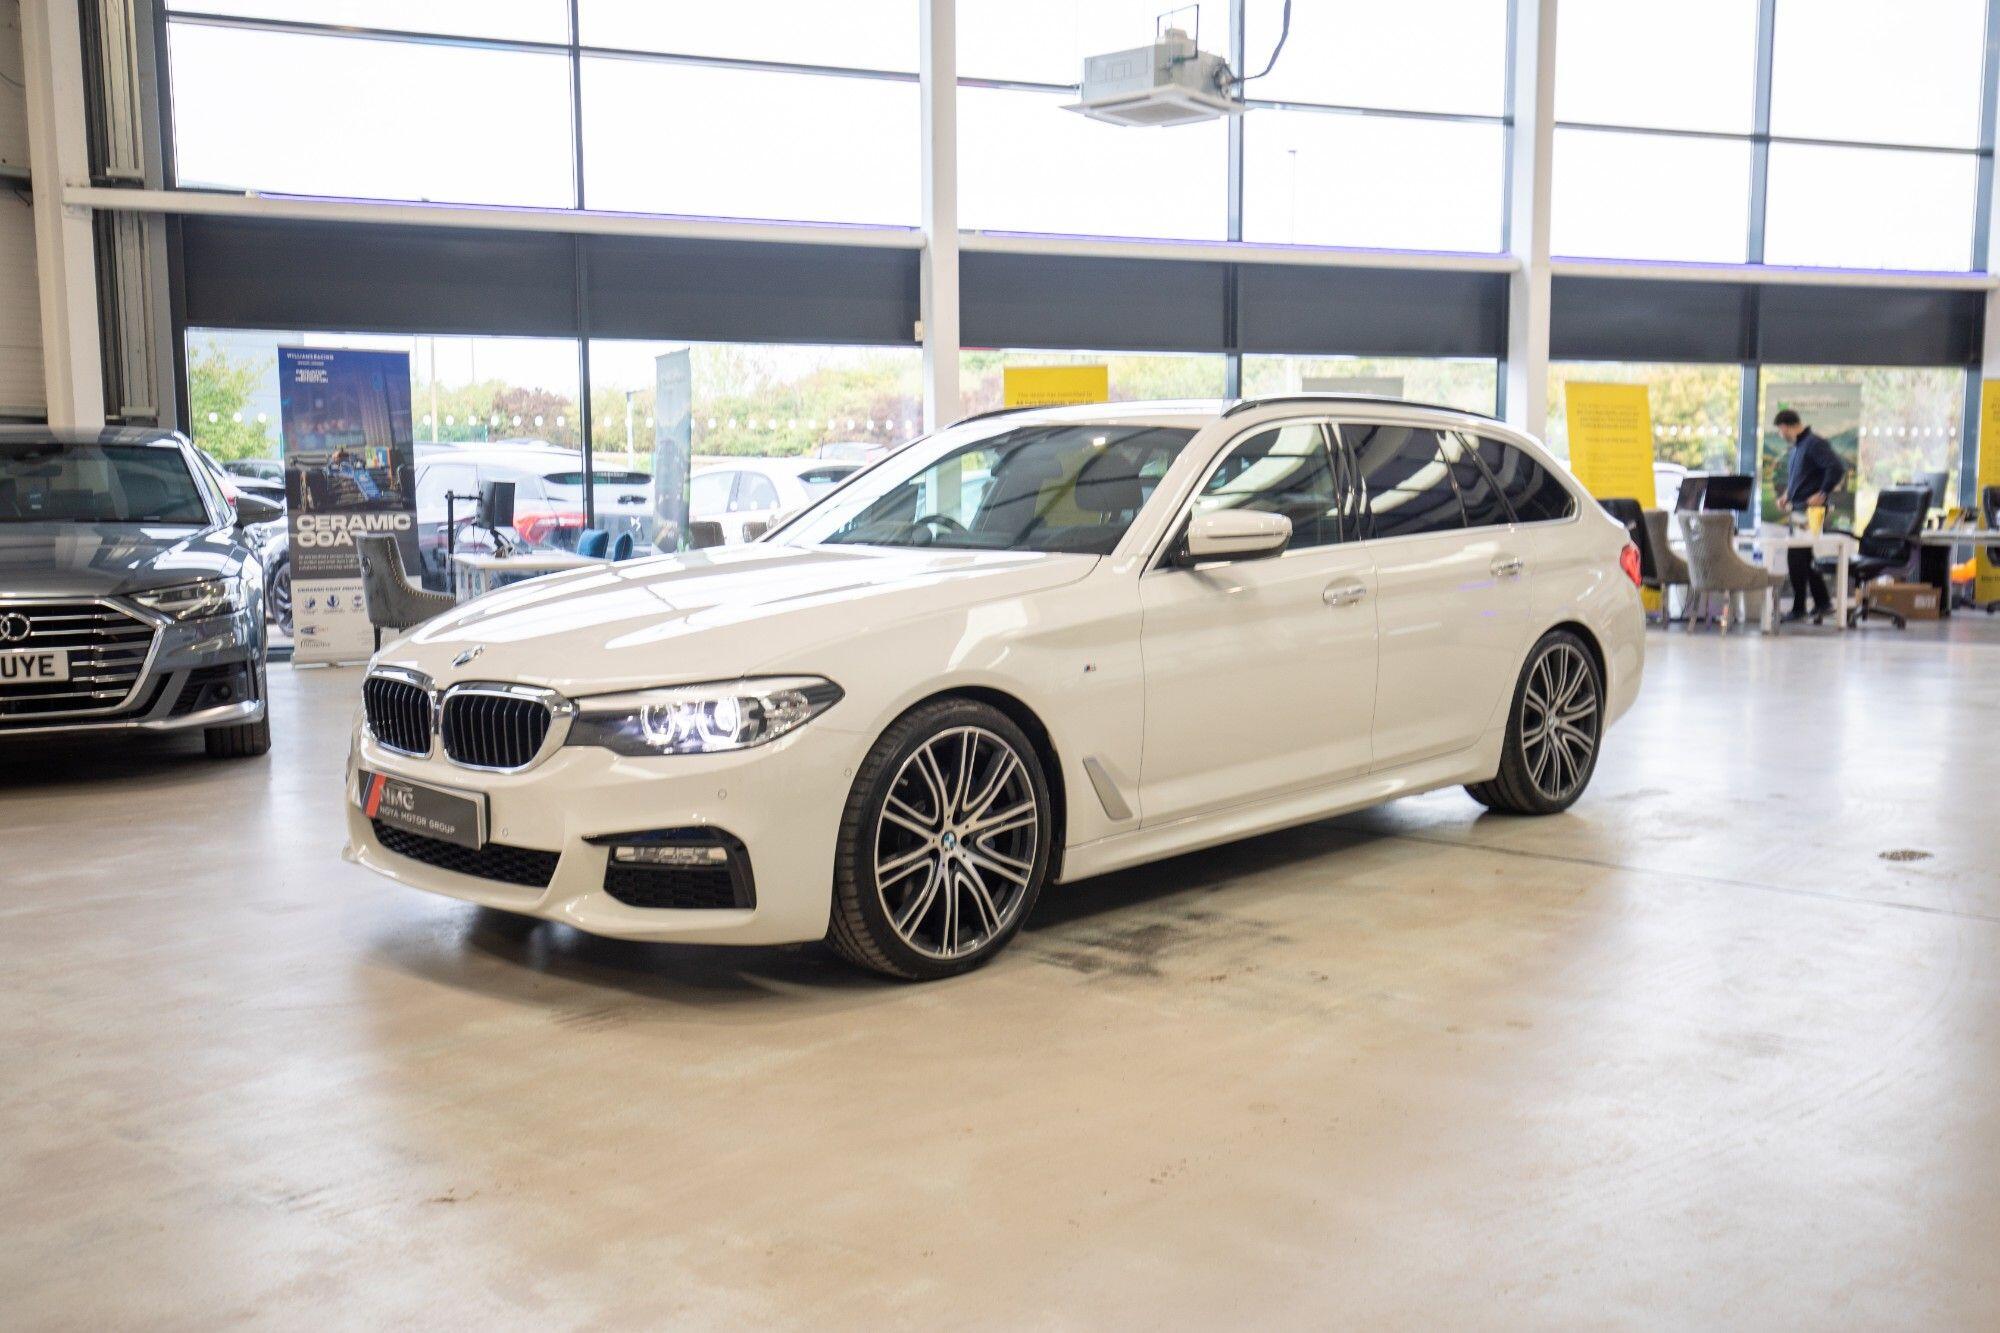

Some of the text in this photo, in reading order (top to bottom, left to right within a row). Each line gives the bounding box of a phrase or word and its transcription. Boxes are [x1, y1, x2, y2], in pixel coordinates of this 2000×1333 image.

[296, 513, 411, 531] CERAMIC
[1, 654, 55, 678] UYE
[401, 811, 427, 826] MOTOR
[429, 819, 456, 834] GROUP
